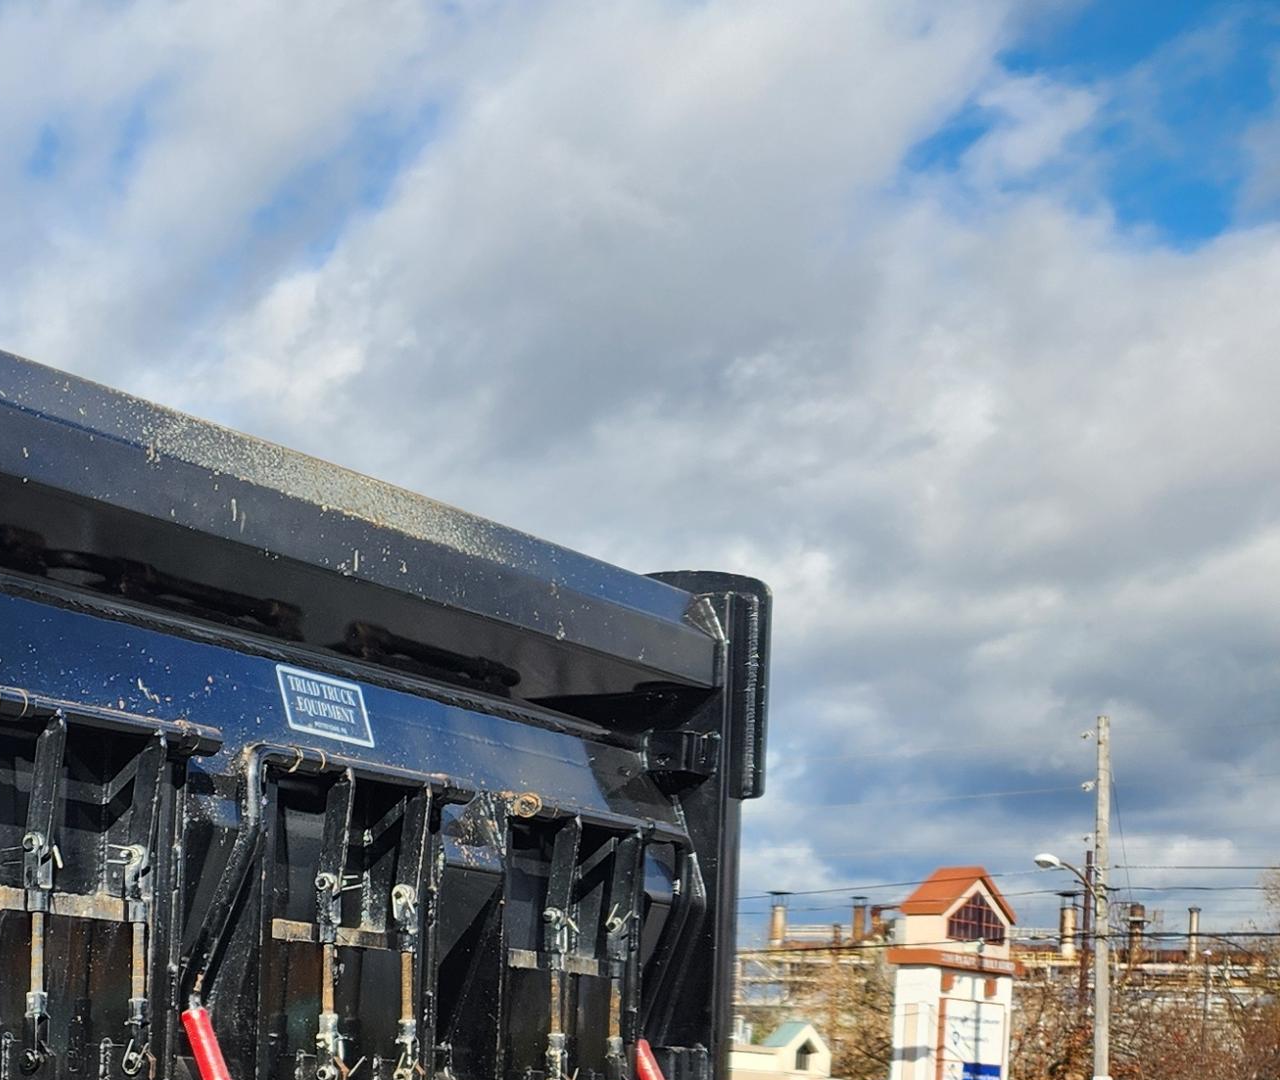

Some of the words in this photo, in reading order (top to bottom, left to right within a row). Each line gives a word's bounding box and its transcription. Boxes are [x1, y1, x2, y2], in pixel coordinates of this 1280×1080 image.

[287, 675, 320, 697] TRIAD
[320, 684, 356, 707] TRUCK
[296, 695, 355, 724] EQUIPMENT
